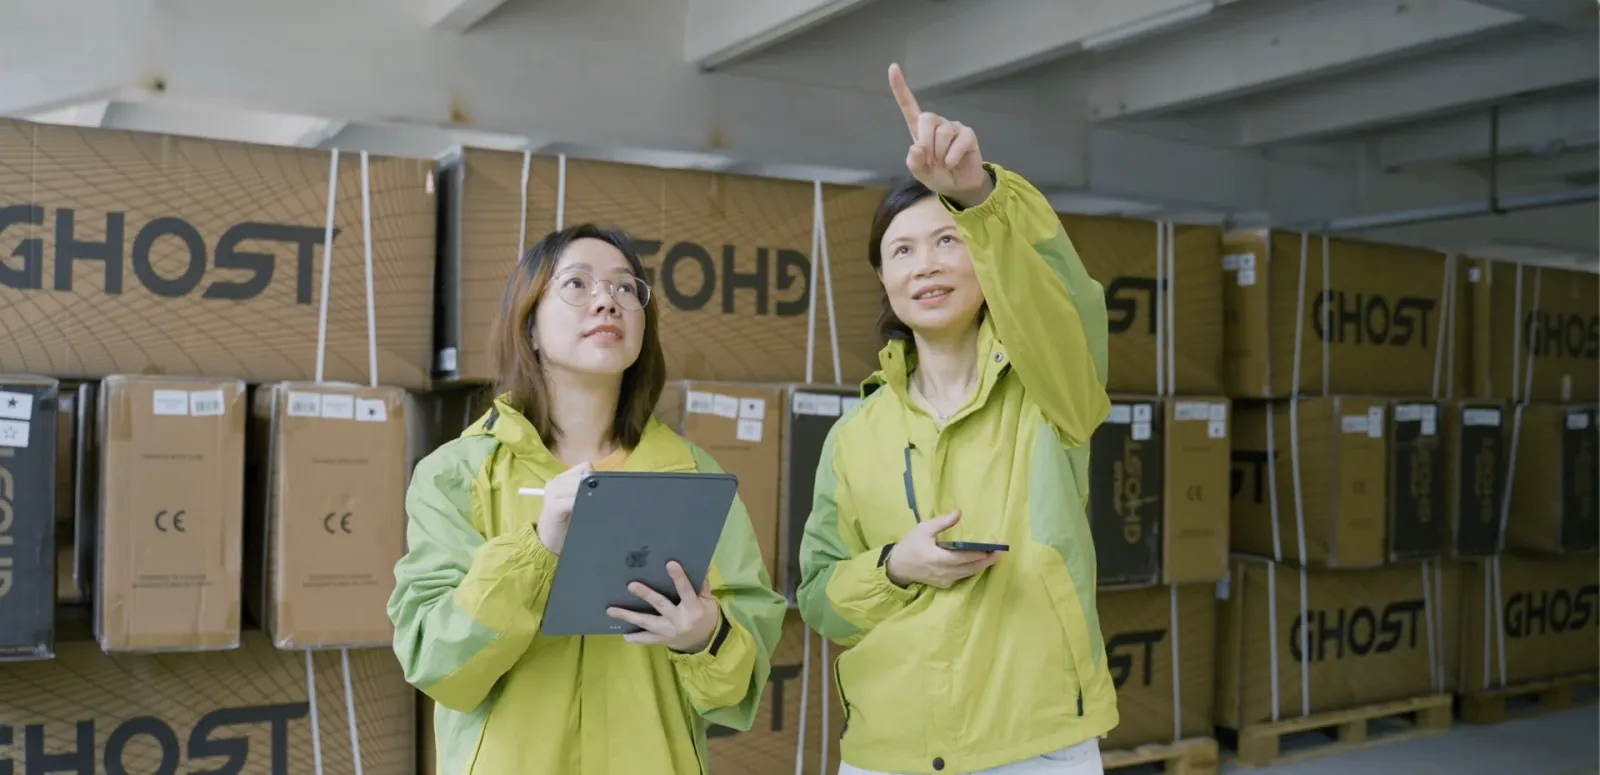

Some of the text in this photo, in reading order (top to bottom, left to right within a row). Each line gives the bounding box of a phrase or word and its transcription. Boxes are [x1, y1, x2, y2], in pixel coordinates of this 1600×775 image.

[0, 204, 341, 305] GHOST
[1312, 289, 1439, 350] GHOST
[154, 510, 186, 532] CE
[324, 512, 353, 534] CE
[1289, 598, 1426, 664] GHOST
[0, 702, 310, 775] HOST
